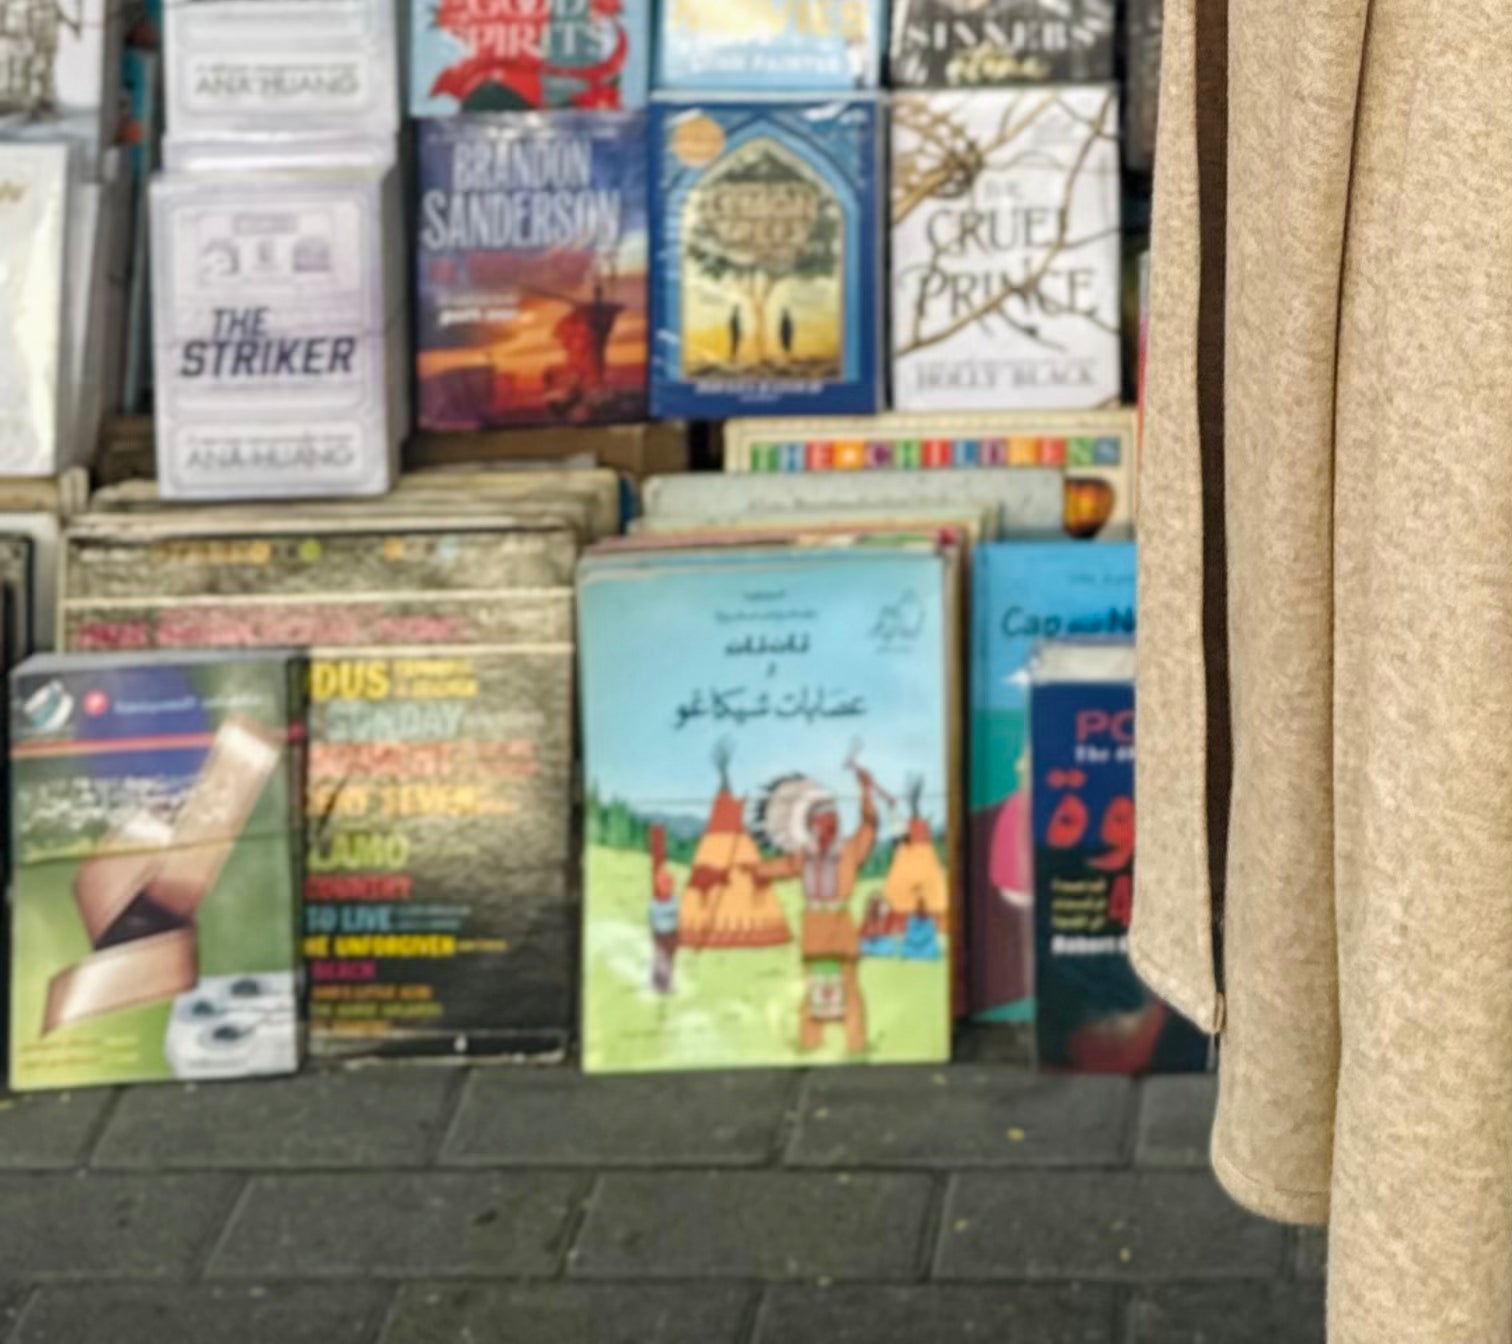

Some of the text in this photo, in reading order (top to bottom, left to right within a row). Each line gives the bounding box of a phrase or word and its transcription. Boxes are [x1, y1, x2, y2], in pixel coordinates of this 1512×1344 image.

[453, 137, 592, 189] BRANDON
[421, 186, 623, 249] SANDERSON
[918, 266, 1098, 318] PRINCE
[212, 306, 271, 339] THE
[180, 336, 357, 378] STRIKER
[915, 359, 1097, 390] HOLLY BLACK
[751, 439, 835, 472] THE
